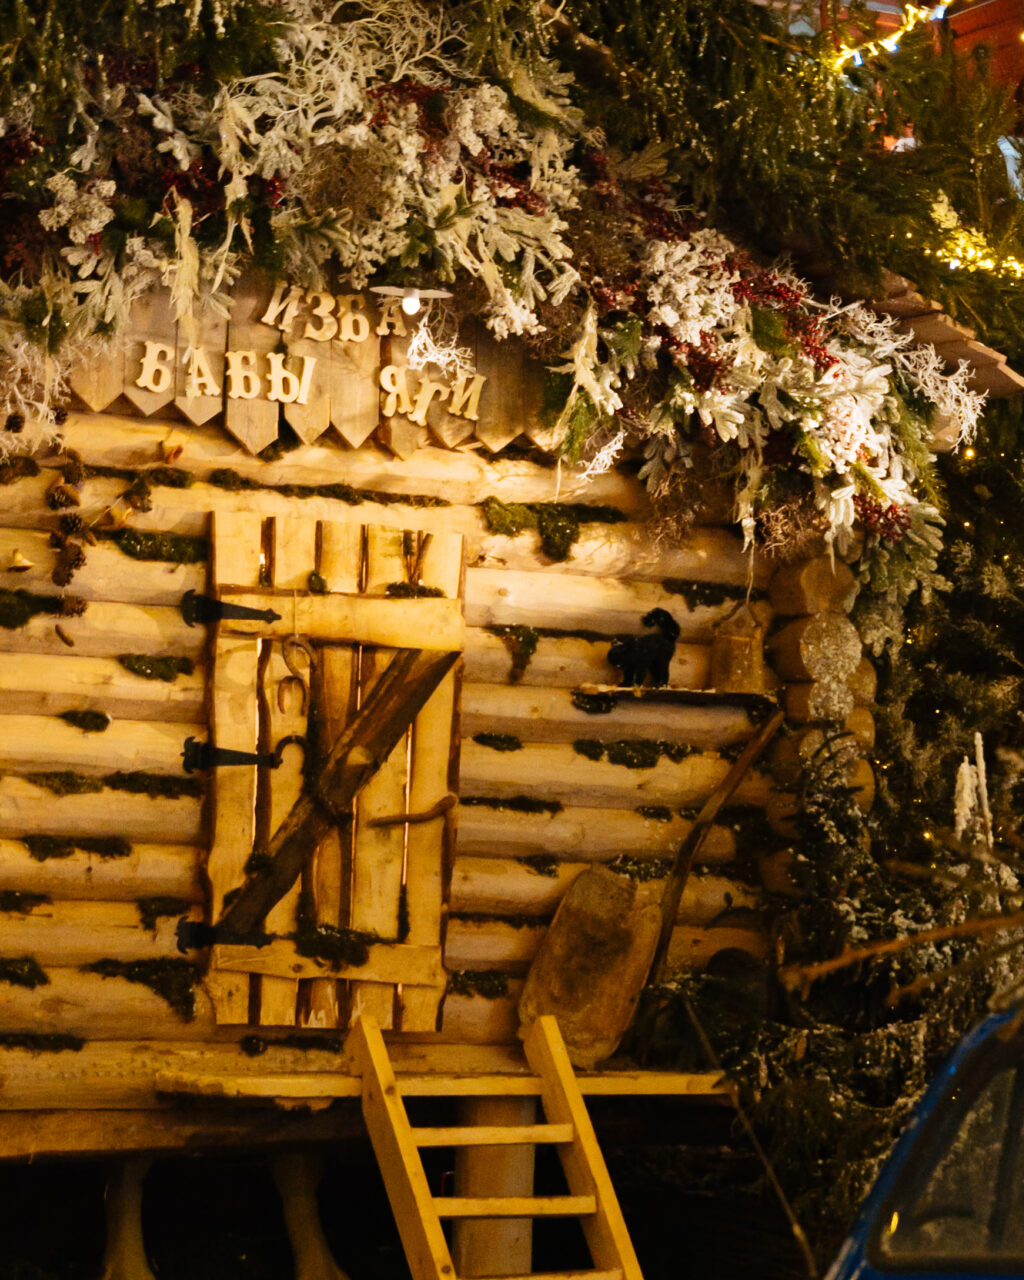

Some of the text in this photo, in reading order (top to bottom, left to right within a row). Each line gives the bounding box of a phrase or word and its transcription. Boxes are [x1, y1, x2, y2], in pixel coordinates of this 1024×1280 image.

[261, 282, 407, 342] ИЗБА
[136, 341, 487, 427] БАБЫ ЯГИ
